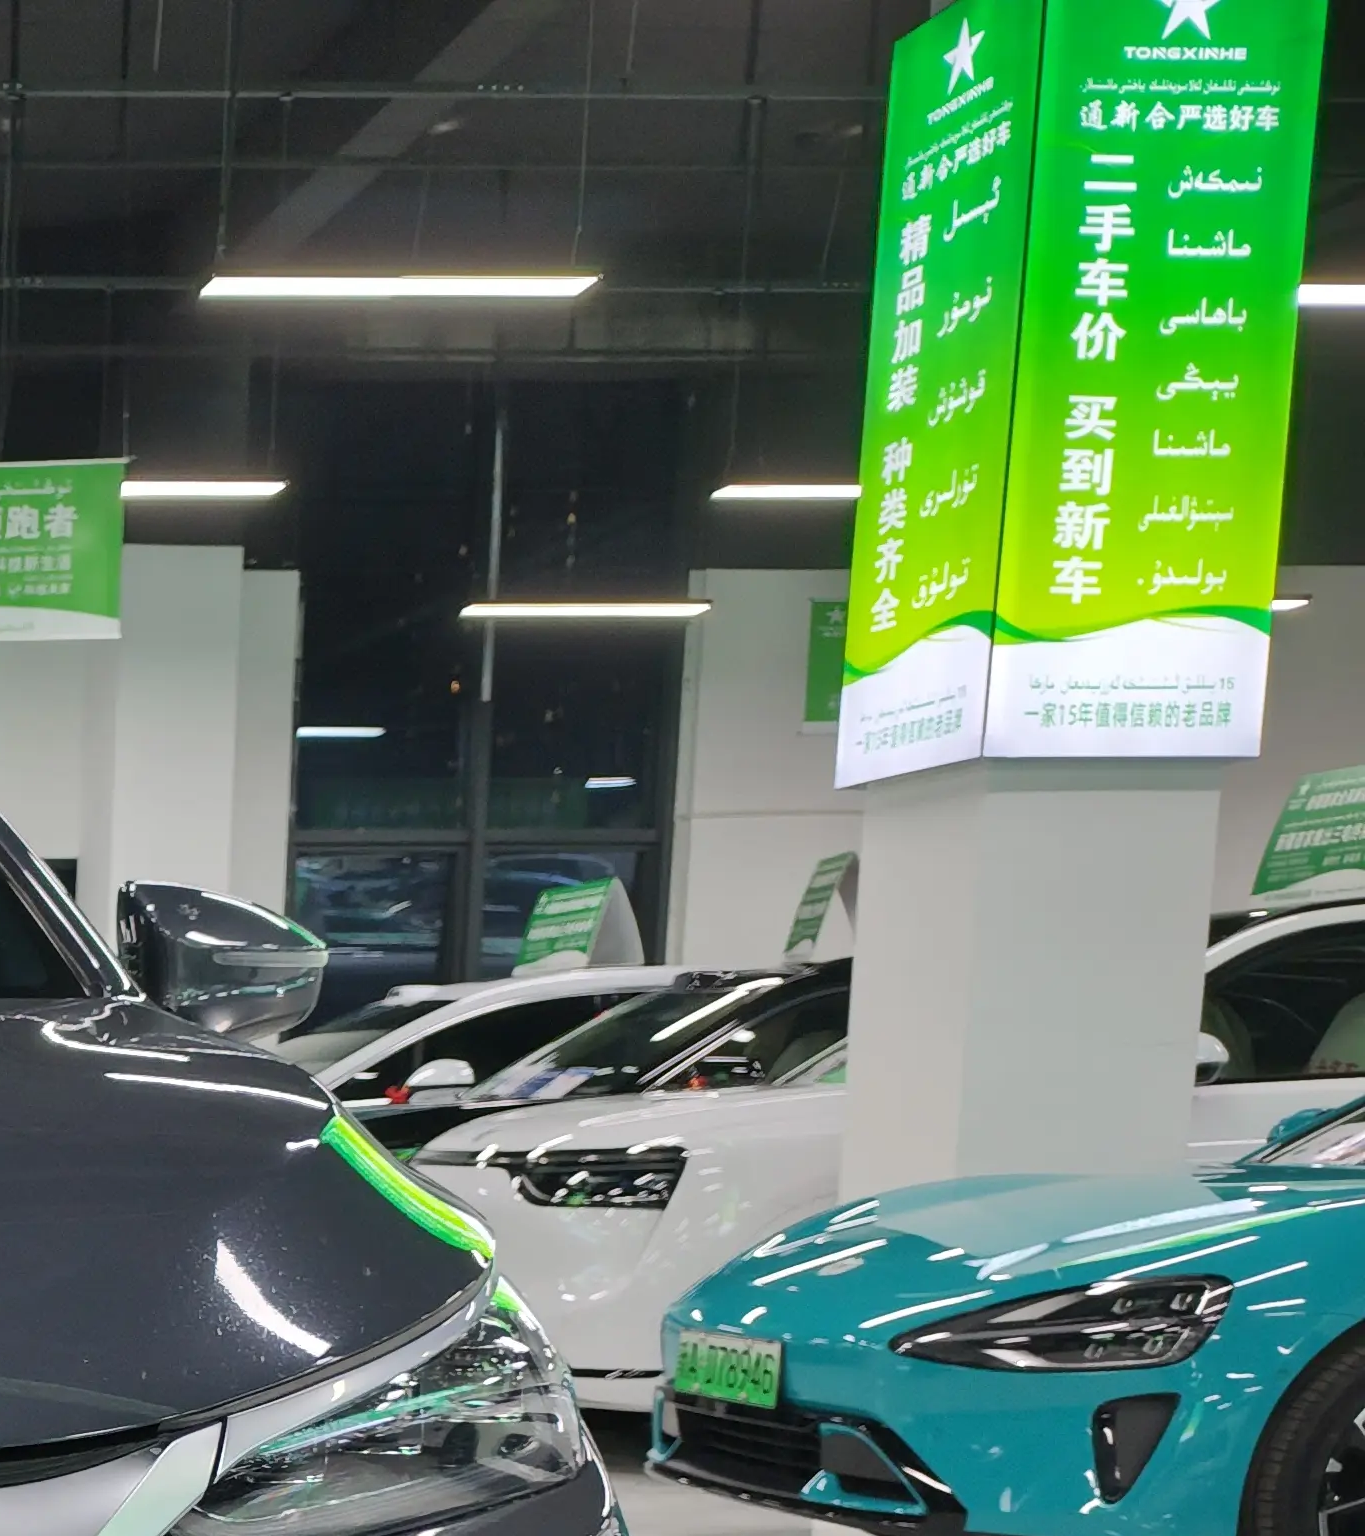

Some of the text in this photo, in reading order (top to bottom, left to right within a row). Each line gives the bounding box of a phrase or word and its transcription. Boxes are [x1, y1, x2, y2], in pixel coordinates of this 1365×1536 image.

[1124, 46, 1247, 60] TONGXINHE
[1079, 99, 1280, 132] 通新合严选好车
[1168, 228, 1251, 257] ماشىنا
[1159, 297, 1247, 335] باھاسى
[1049, 154, 1137, 604] 二手车价 买到新车
[1156, 362, 1239, 400] يېڭى
[870, 214, 931, 632] 精品加装 种类齐全
[1153, 429, 1231, 457] ماشىنا
[1219, 678, 1235, 690] 15
[1024, 702, 1232, 729] 一家15年值得信赖的老品牌
